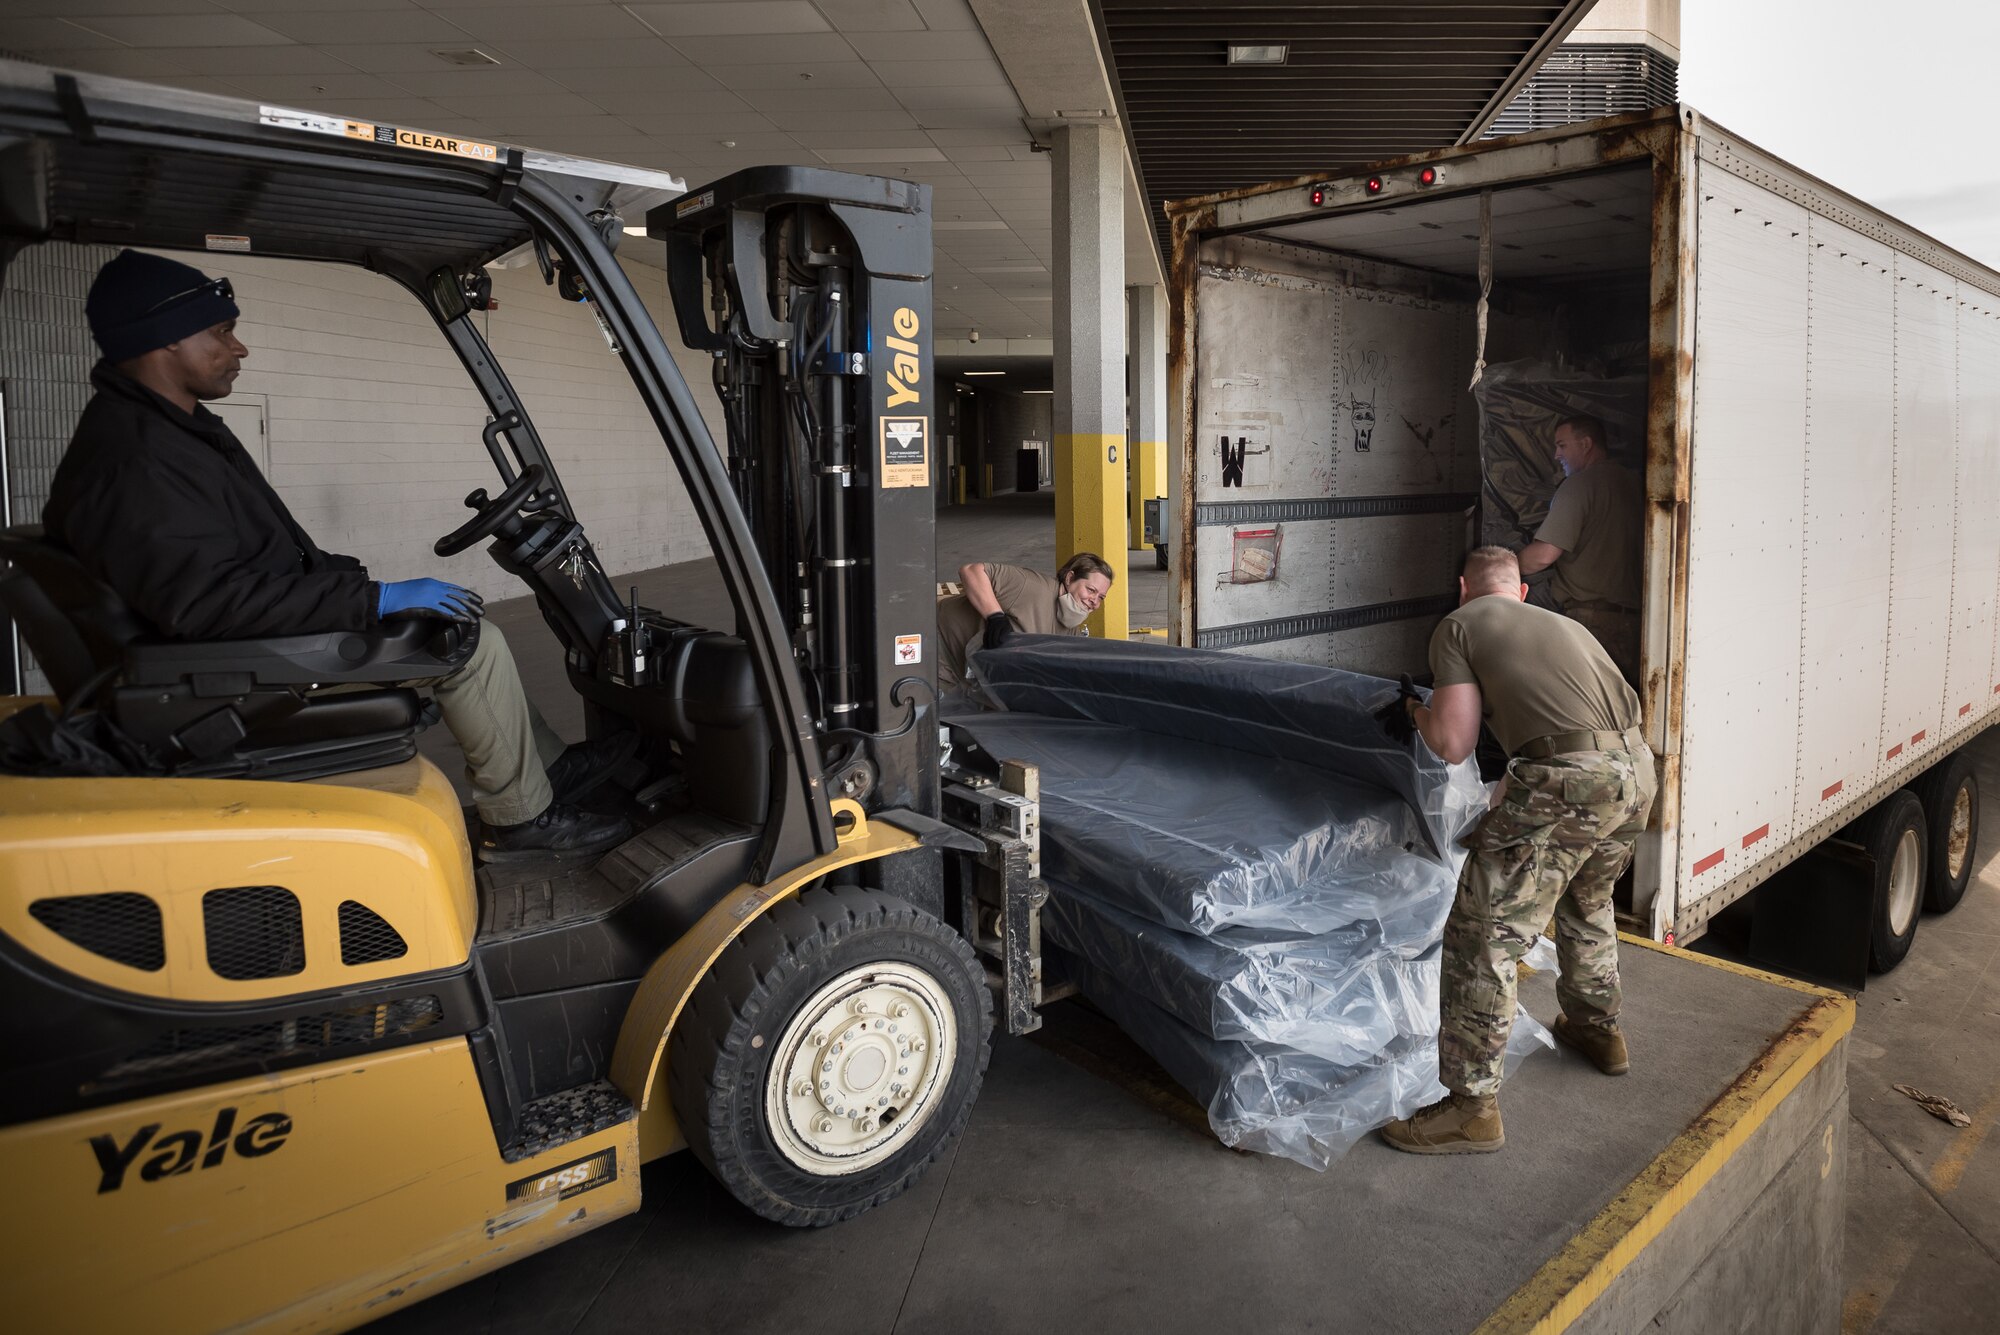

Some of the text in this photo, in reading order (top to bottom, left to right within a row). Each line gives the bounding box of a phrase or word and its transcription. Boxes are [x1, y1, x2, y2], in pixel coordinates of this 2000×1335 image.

[400, 132, 494, 158] CLEARCAP
[886, 307, 919, 408] Yale
[1108, 444, 1117, 463] C
[89, 1107, 293, 1195] Yale
[1821, 1124, 1833, 1179] 3
